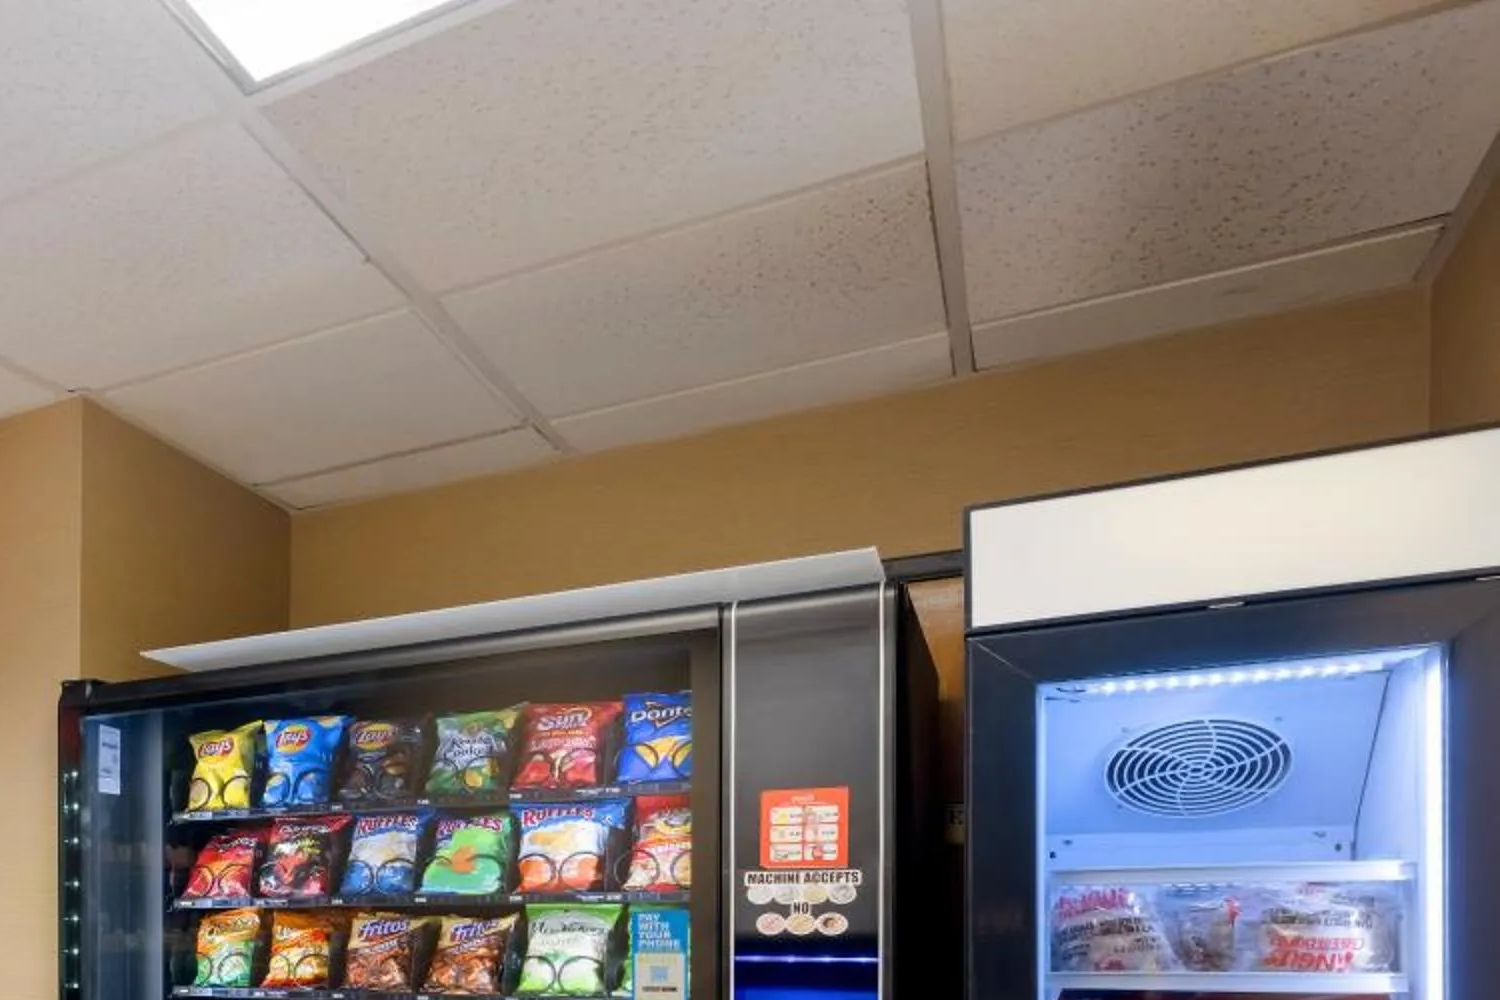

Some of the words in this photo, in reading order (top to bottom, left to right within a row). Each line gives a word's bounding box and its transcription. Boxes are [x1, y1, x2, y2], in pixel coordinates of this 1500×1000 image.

[747, 874, 800, 885] MACHINE
[803, 871, 860, 884] ACCEPTS
[793, 902, 809, 914] NO
